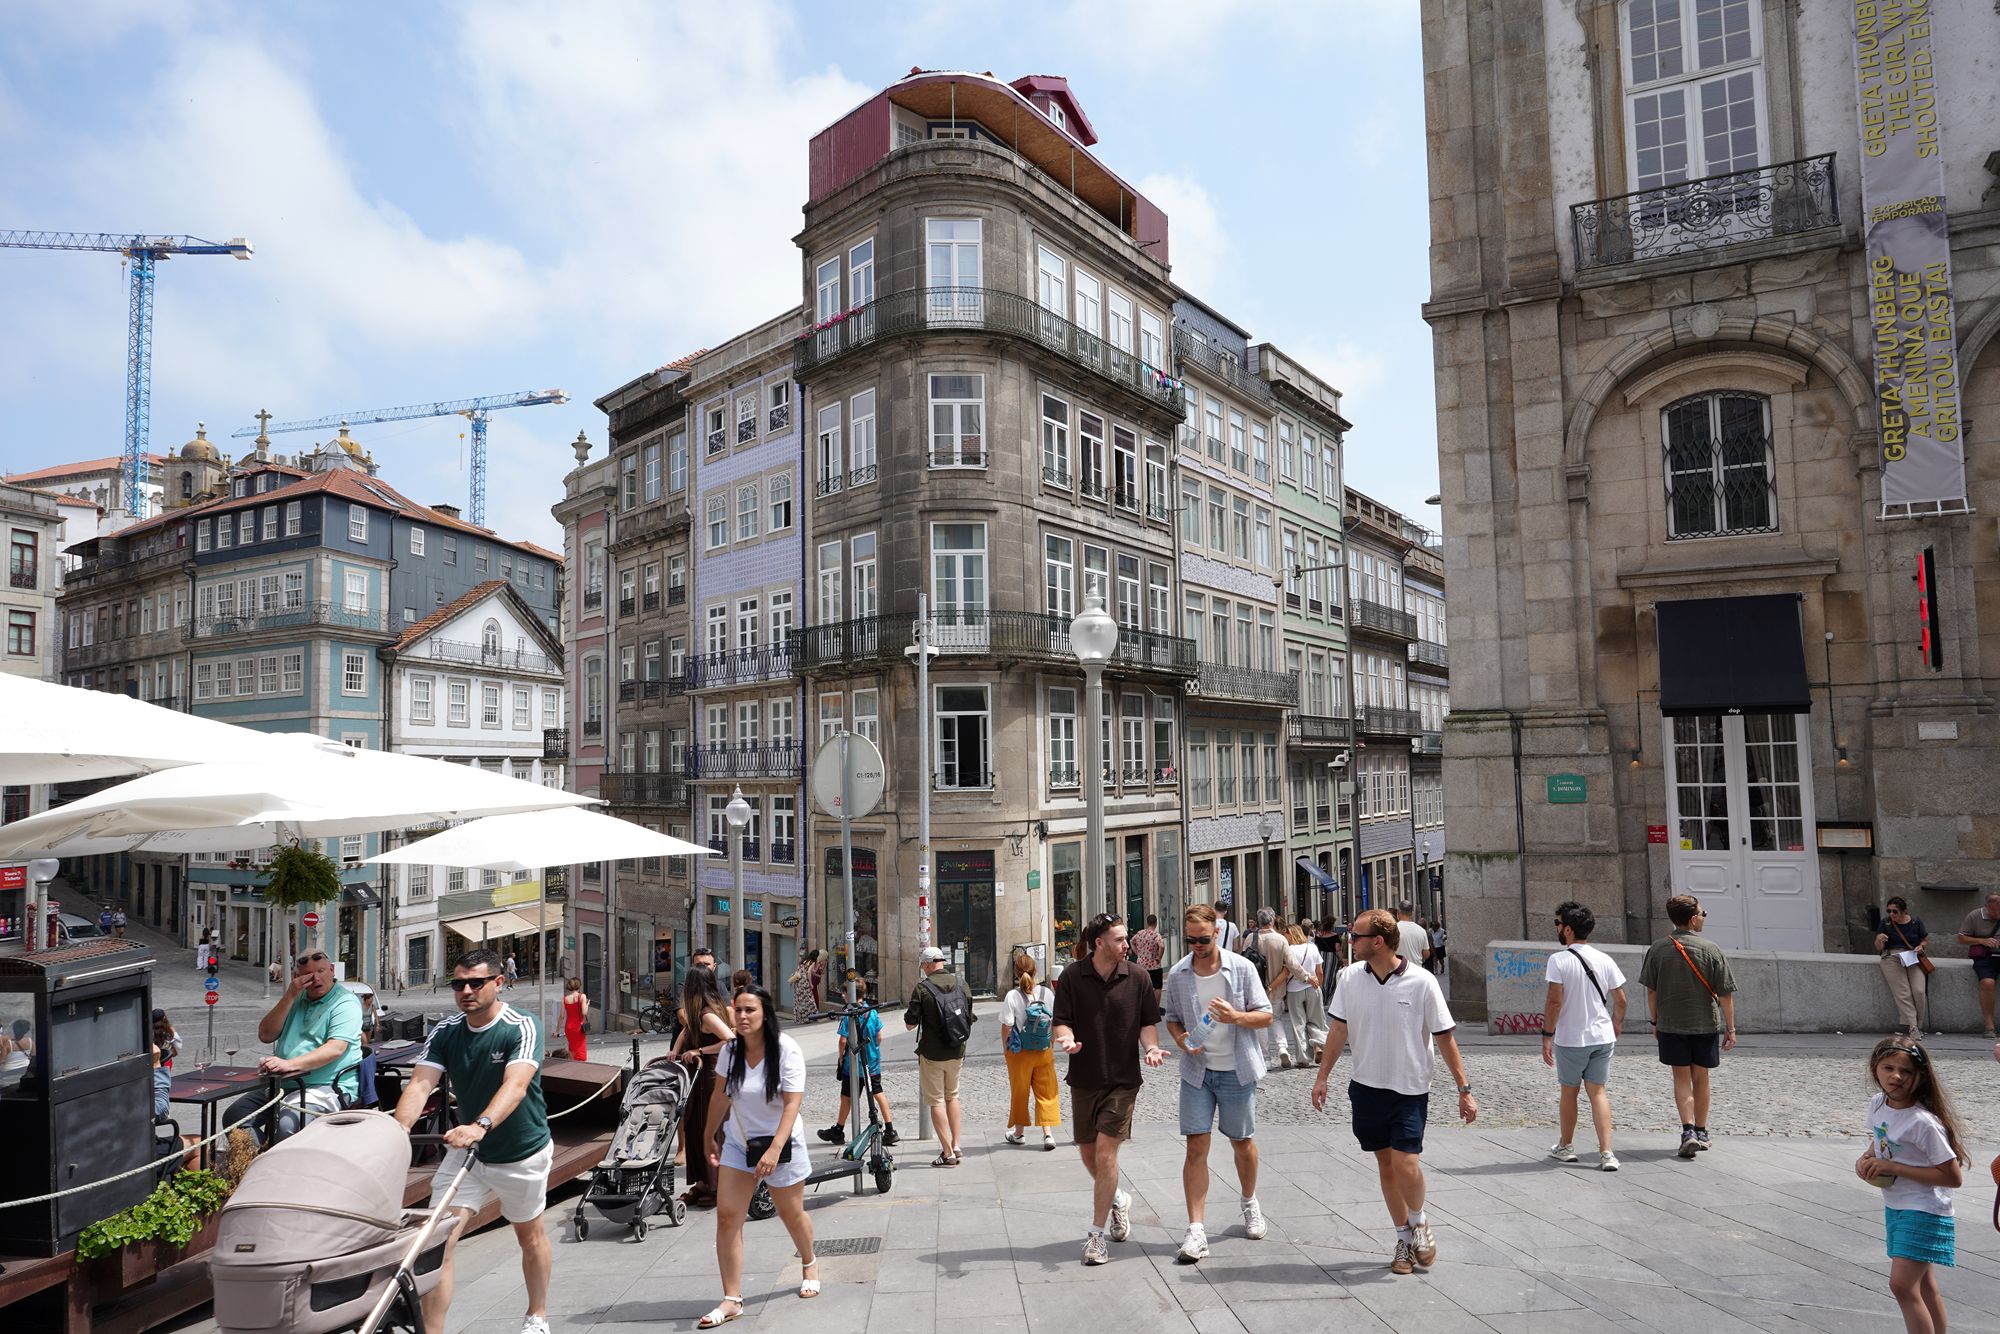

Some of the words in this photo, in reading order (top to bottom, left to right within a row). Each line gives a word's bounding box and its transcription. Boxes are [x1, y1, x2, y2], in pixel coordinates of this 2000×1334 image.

[1882, 33, 1908, 86] GIRL
[1862, 84, 1887, 158] GRETA
[1887, 89, 1911, 137] THE
[1910, 44, 1939, 159] SHOUTED:
[1872, 255, 1901, 384] THUNBERG
[1898, 271, 1926, 322] QUE
[1923, 261, 1952, 342] BASTA!
[1903, 324, 1931, 418] MENINA
[1929, 347, 1960, 443] GRITOU:
[1880, 384, 1907, 462] GRETA
[1909, 421, 1932, 439] A
[1728, 707, 1741, 715] dop
